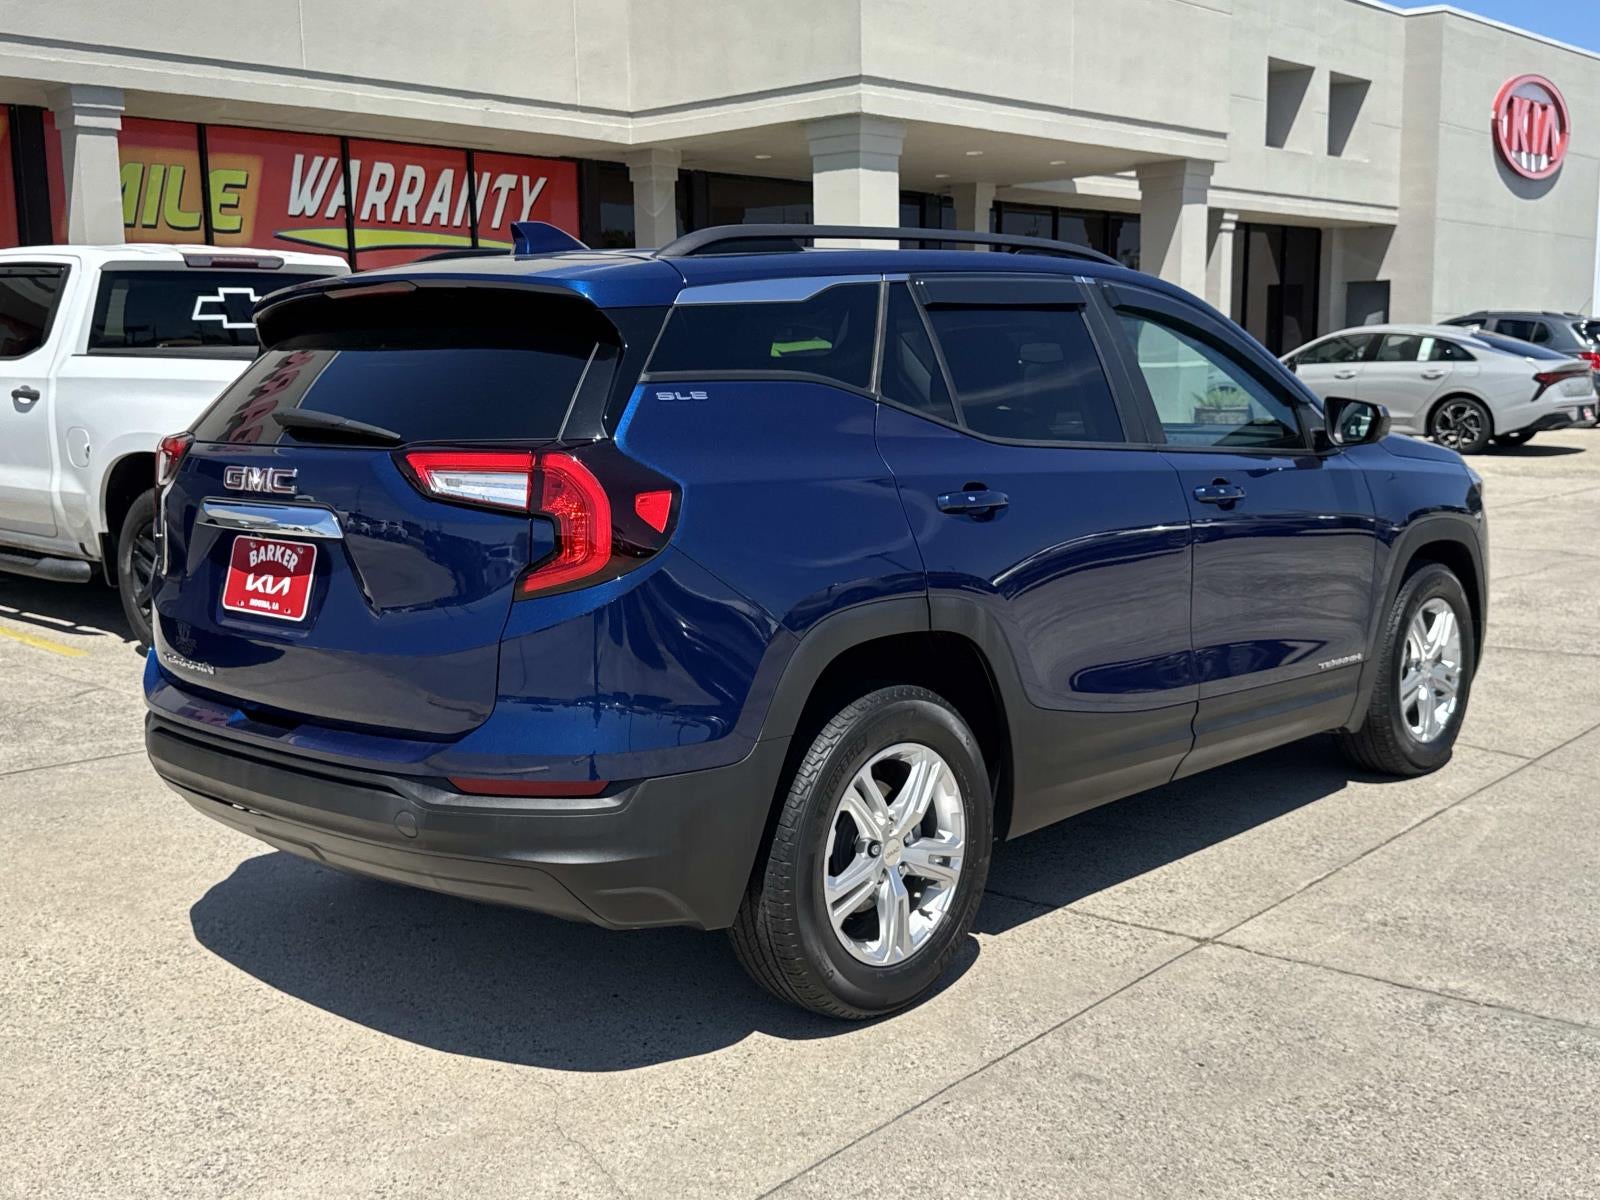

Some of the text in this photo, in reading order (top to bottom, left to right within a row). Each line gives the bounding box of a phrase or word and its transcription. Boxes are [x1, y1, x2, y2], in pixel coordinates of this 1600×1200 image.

[287, 153, 548, 230] WARRANTY
[656, 391, 708, 401] SLE
[224, 465, 298, 494] GMC
[249, 544, 298, 573] BARKER
[245, 573, 291, 597] KIA
